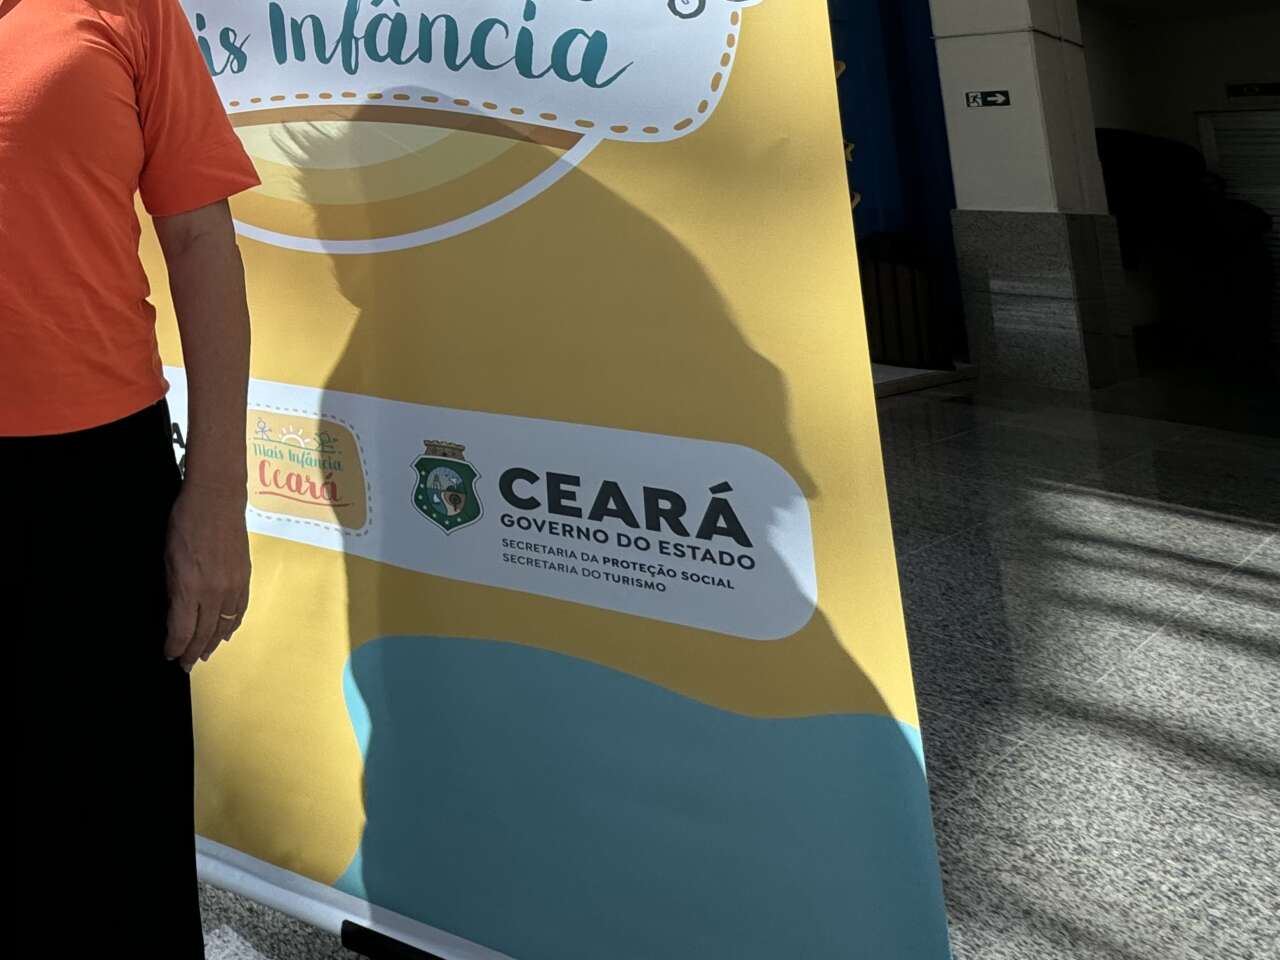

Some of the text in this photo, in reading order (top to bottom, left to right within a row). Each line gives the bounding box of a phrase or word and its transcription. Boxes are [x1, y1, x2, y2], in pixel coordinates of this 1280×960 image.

[253, 443, 343, 472] Mais Infância
[258, 458, 343, 502] Ceará
[498, 467, 754, 548] CEARÁ
[500, 513, 756, 571] GOVERNO DO ESTADO
[501, 538, 735, 590] SECRETARIA DA PROTEÇÃO SOCIAL
[502, 553, 667, 593] SECRETARIA DO TURISMO
